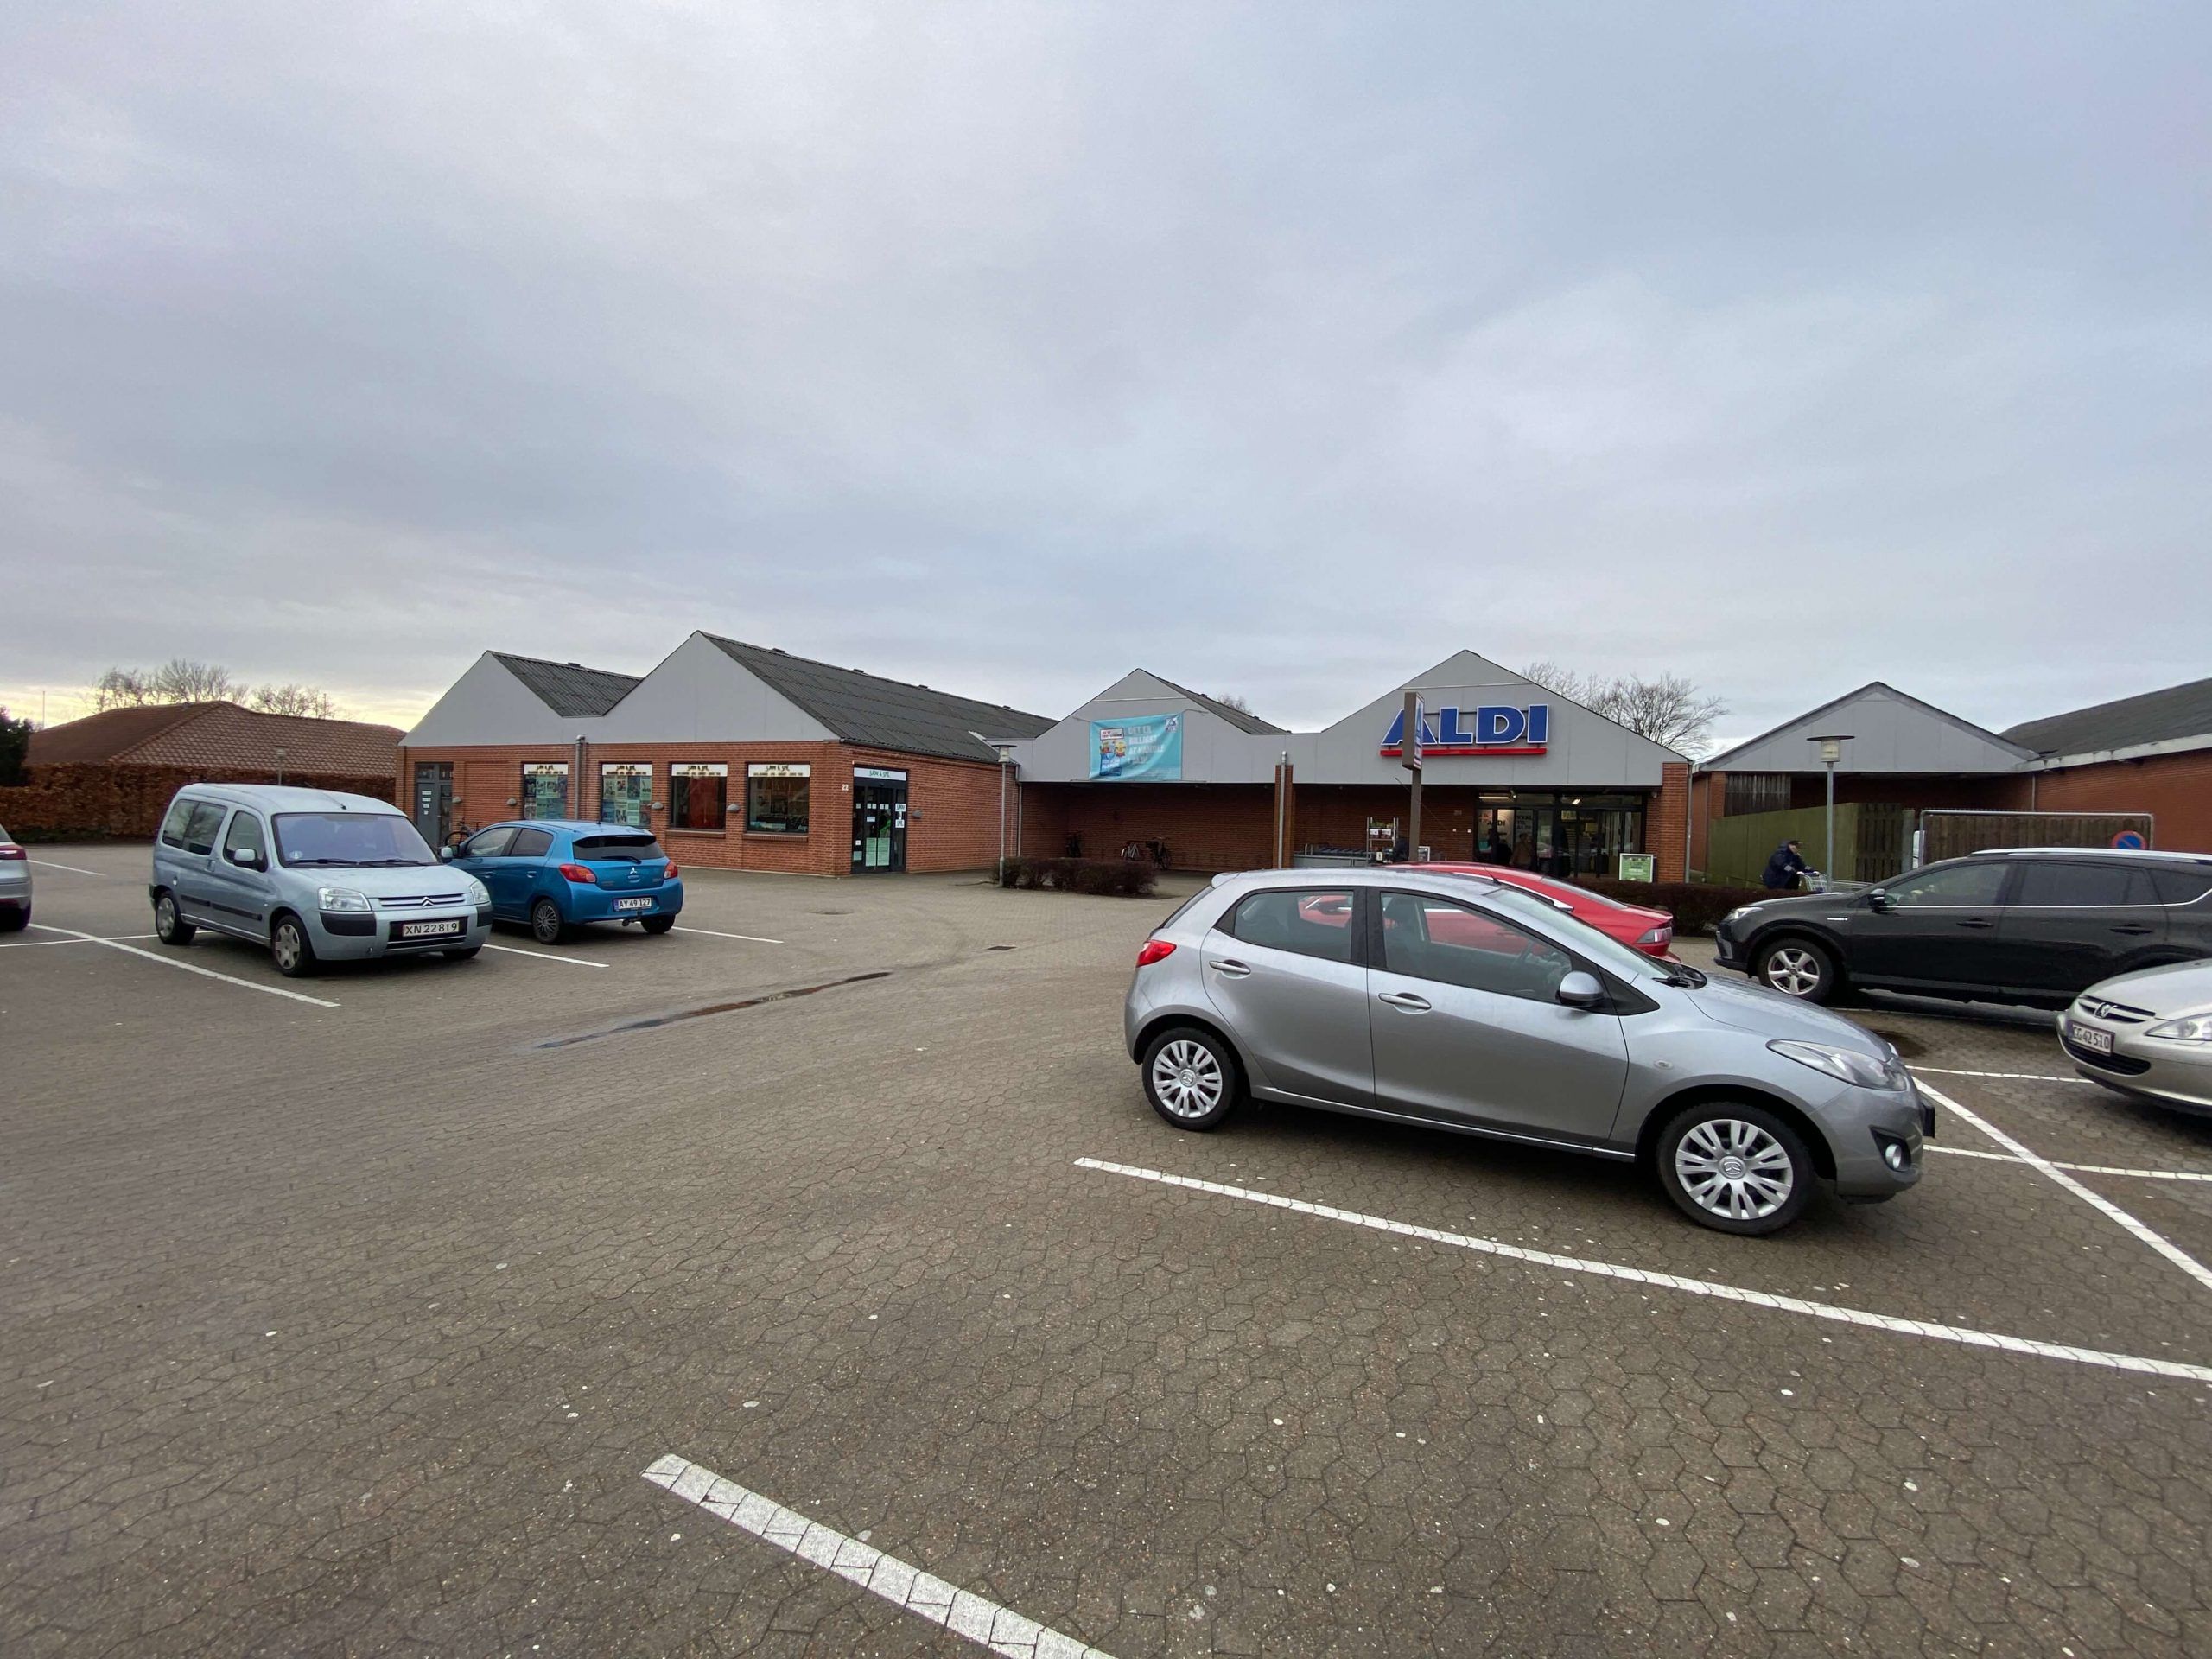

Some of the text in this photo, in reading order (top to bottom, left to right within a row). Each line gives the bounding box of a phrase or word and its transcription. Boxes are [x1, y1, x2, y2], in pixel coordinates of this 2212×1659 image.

[1381, 704, 1548, 745] ALDI
[405, 922, 457, 935] XN 22 819
